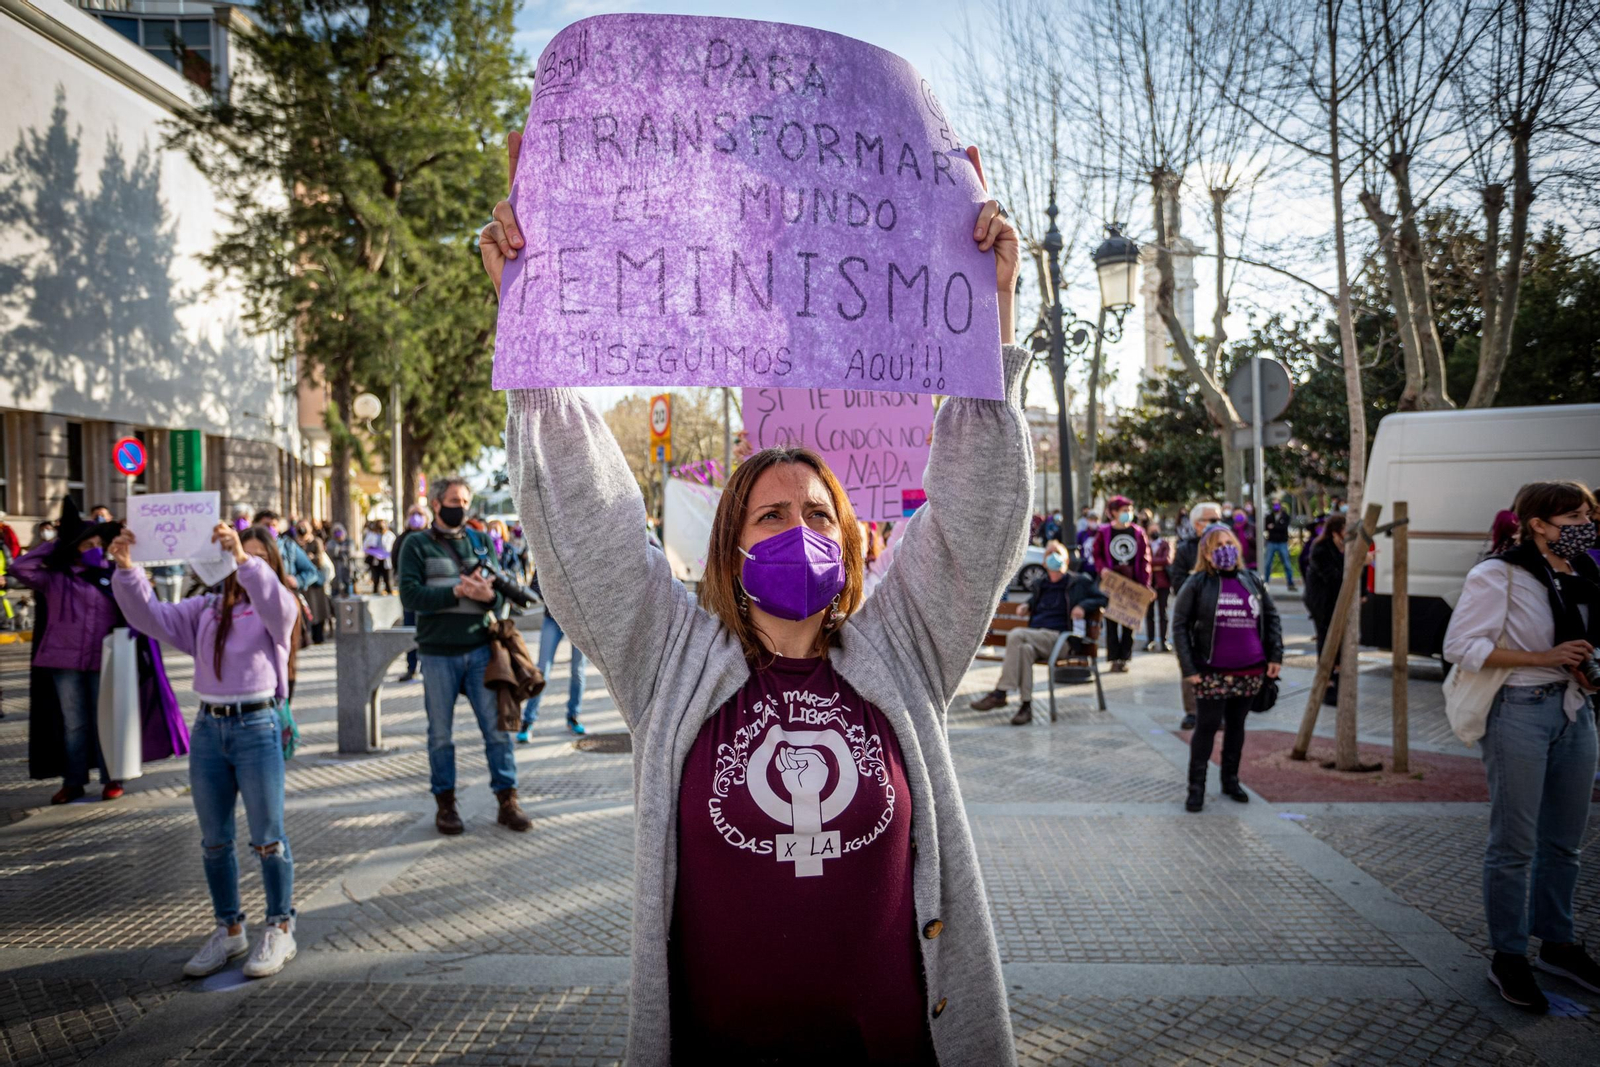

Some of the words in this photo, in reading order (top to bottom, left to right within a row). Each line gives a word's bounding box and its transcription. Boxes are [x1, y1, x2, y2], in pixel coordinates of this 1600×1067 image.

[702, 38, 828, 98] PARA
[542, 110, 957, 187] TRANSFORMAR
[612, 185, 663, 223] EL
[739, 182, 898, 232] MUNDO
[518, 245, 973, 335] FEMINISMO
[757, 389, 785, 413] SI
[900, 425, 928, 448] NO
[845, 451, 913, 486] NADA
[708, 797, 773, 854] UNIDAS
[810, 836, 834, 857] LA
[842, 784, 896, 853] IGUALDAD
